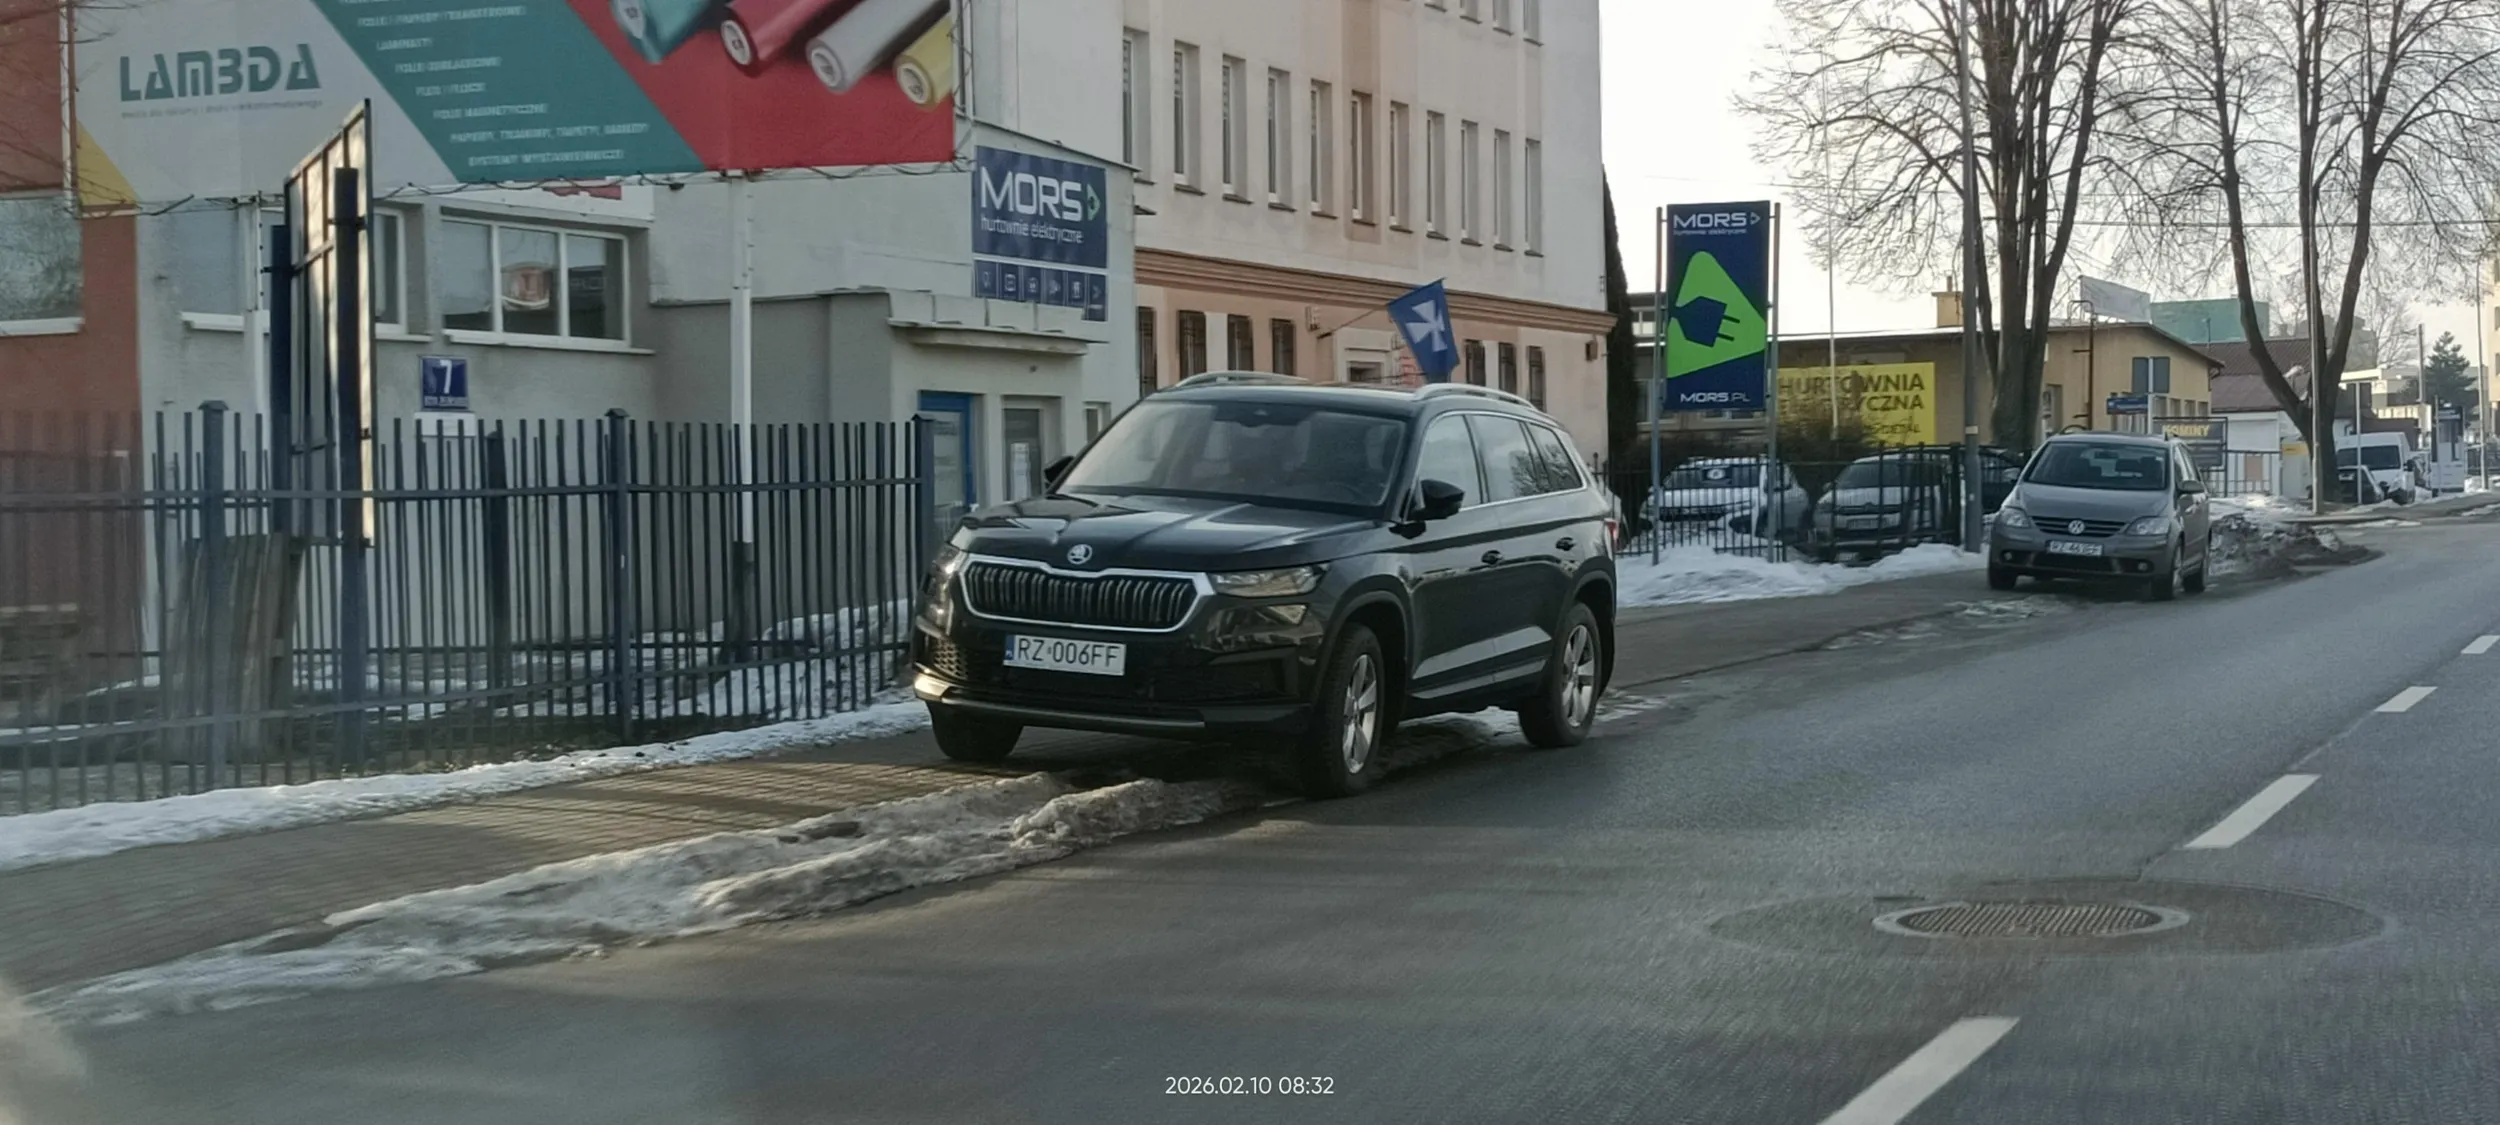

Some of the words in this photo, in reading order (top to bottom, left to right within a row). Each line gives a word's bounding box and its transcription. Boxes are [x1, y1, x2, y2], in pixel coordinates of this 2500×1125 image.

[981, 166, 1082, 222] MORS
[980, 214, 1030, 237] hurtownie
[1030, 221, 1084, 245] elektryczne
[1673, 212, 1747, 229] MORS
[439, 359, 453, 395] 7
[1018, 638, 1045, 662] RZ
[1052, 641, 1120, 667] 006FF
